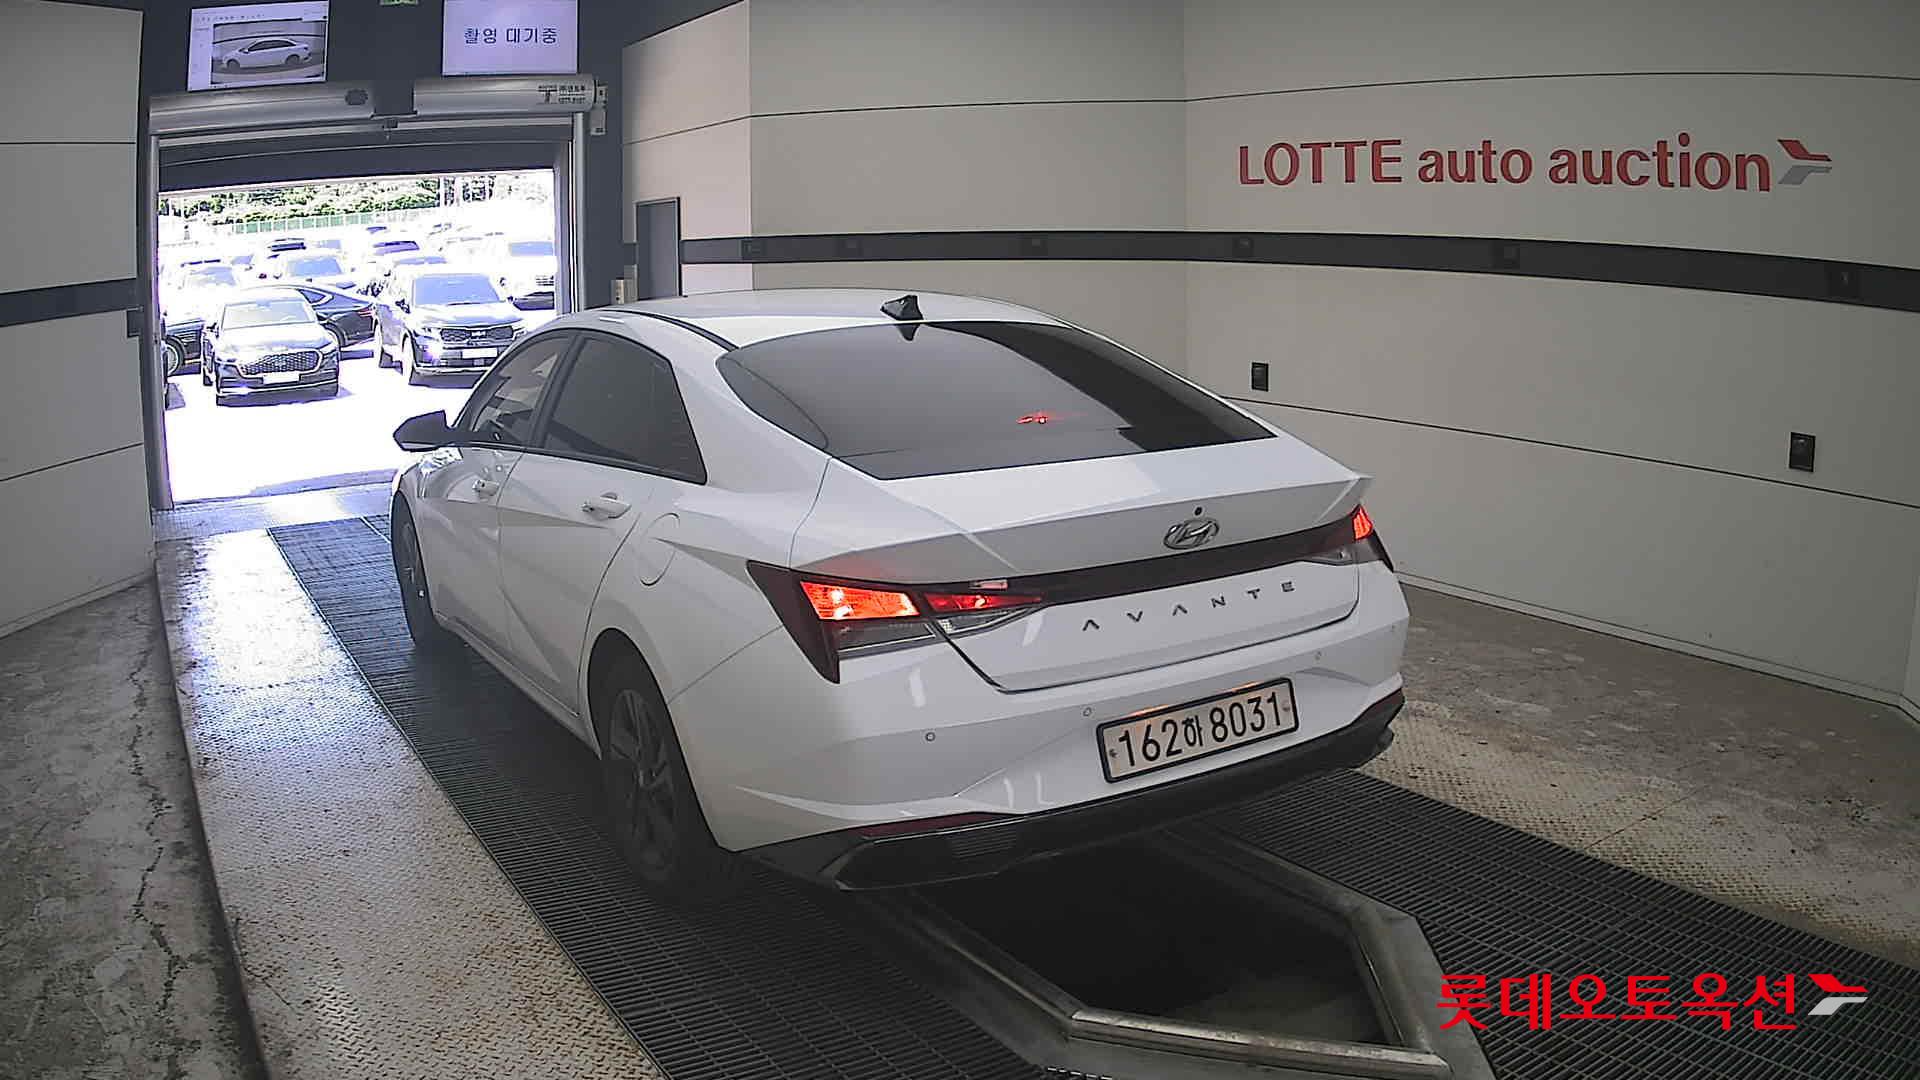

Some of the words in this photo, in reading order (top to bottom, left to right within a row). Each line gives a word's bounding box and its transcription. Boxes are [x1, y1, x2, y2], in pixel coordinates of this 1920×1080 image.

[464, 28, 497, 44] 촬영
[506, 28, 557, 44] 대기중
[1239, 139, 1402, 186] LOTTE
[1417, 140, 1533, 184] auto
[1548, 132, 1770, 192] auction
[1083, 582, 1295, 631] AVANTE
